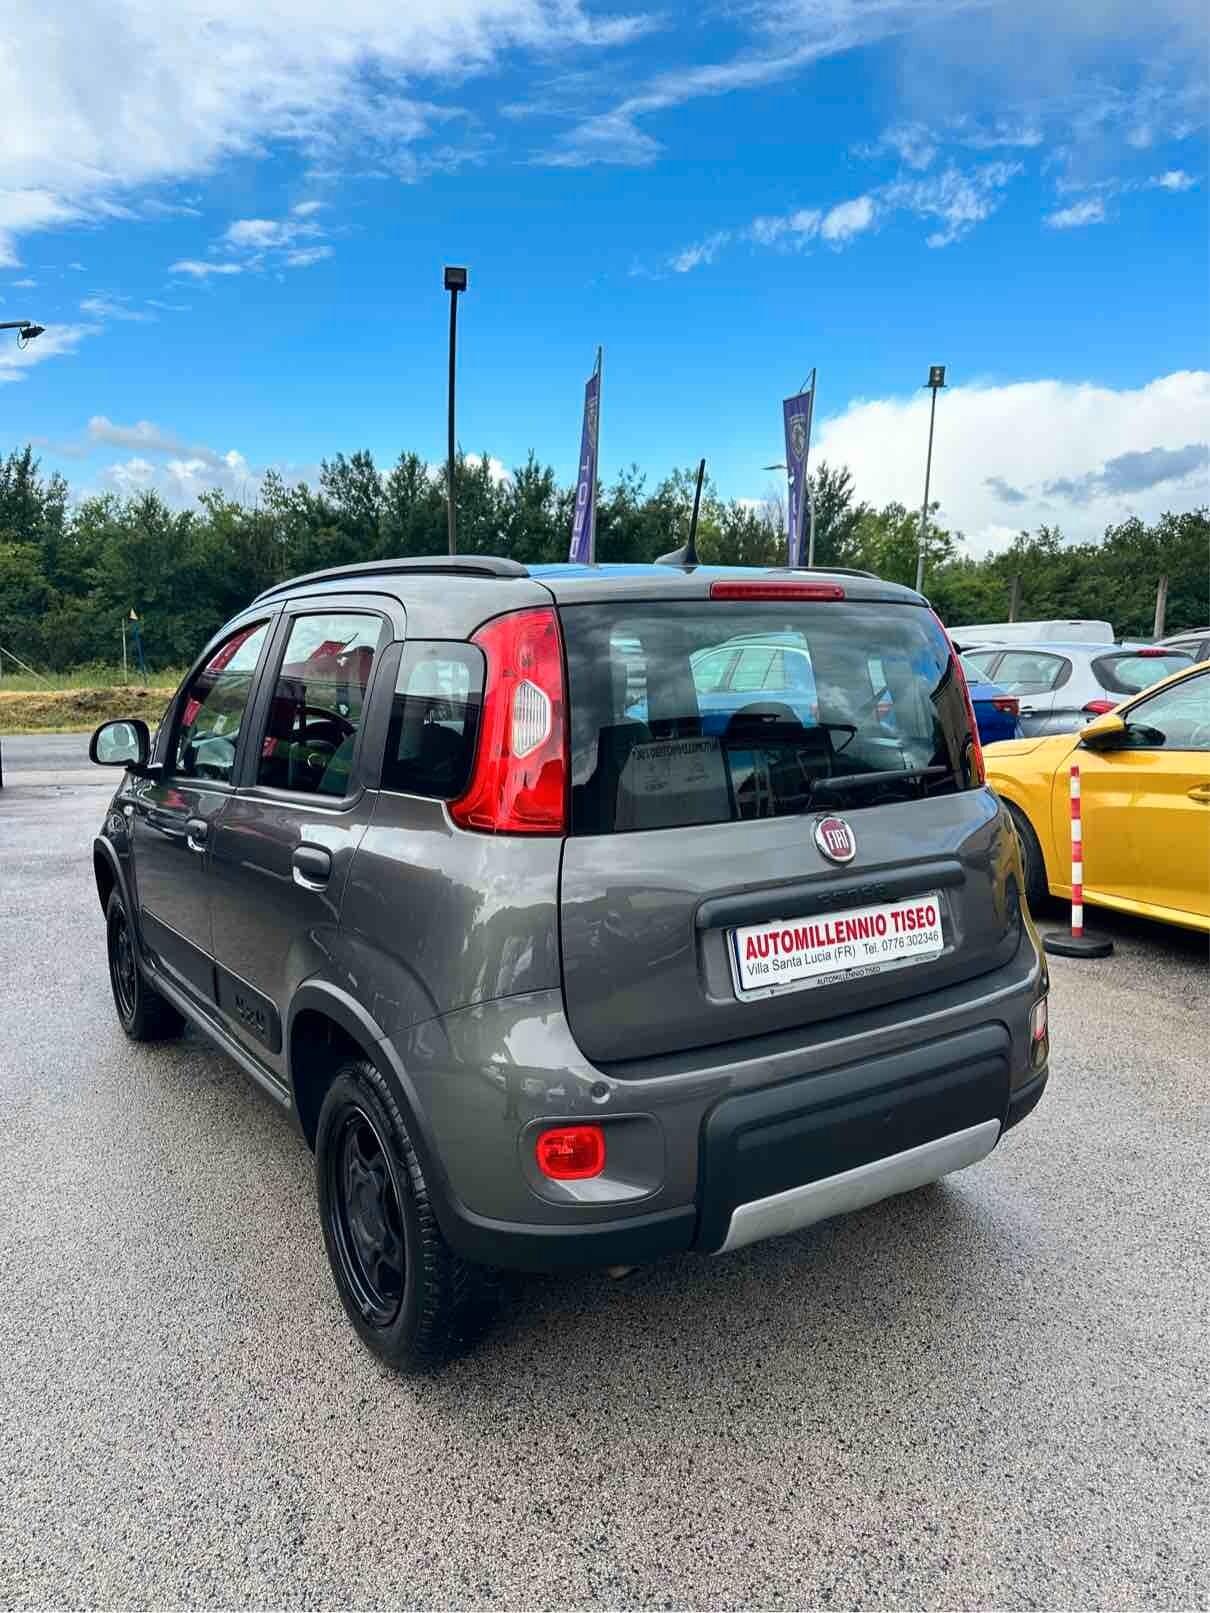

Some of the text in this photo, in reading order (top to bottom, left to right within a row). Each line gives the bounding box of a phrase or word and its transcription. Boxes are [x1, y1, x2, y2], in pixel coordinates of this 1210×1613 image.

[825, 829, 849, 850] FIAT
[746, 905, 936, 960] AUTOMILLENNIO TISEO
[747, 930, 939, 976] Villa Santa Lucia (FR) Tel. 0776 302346
